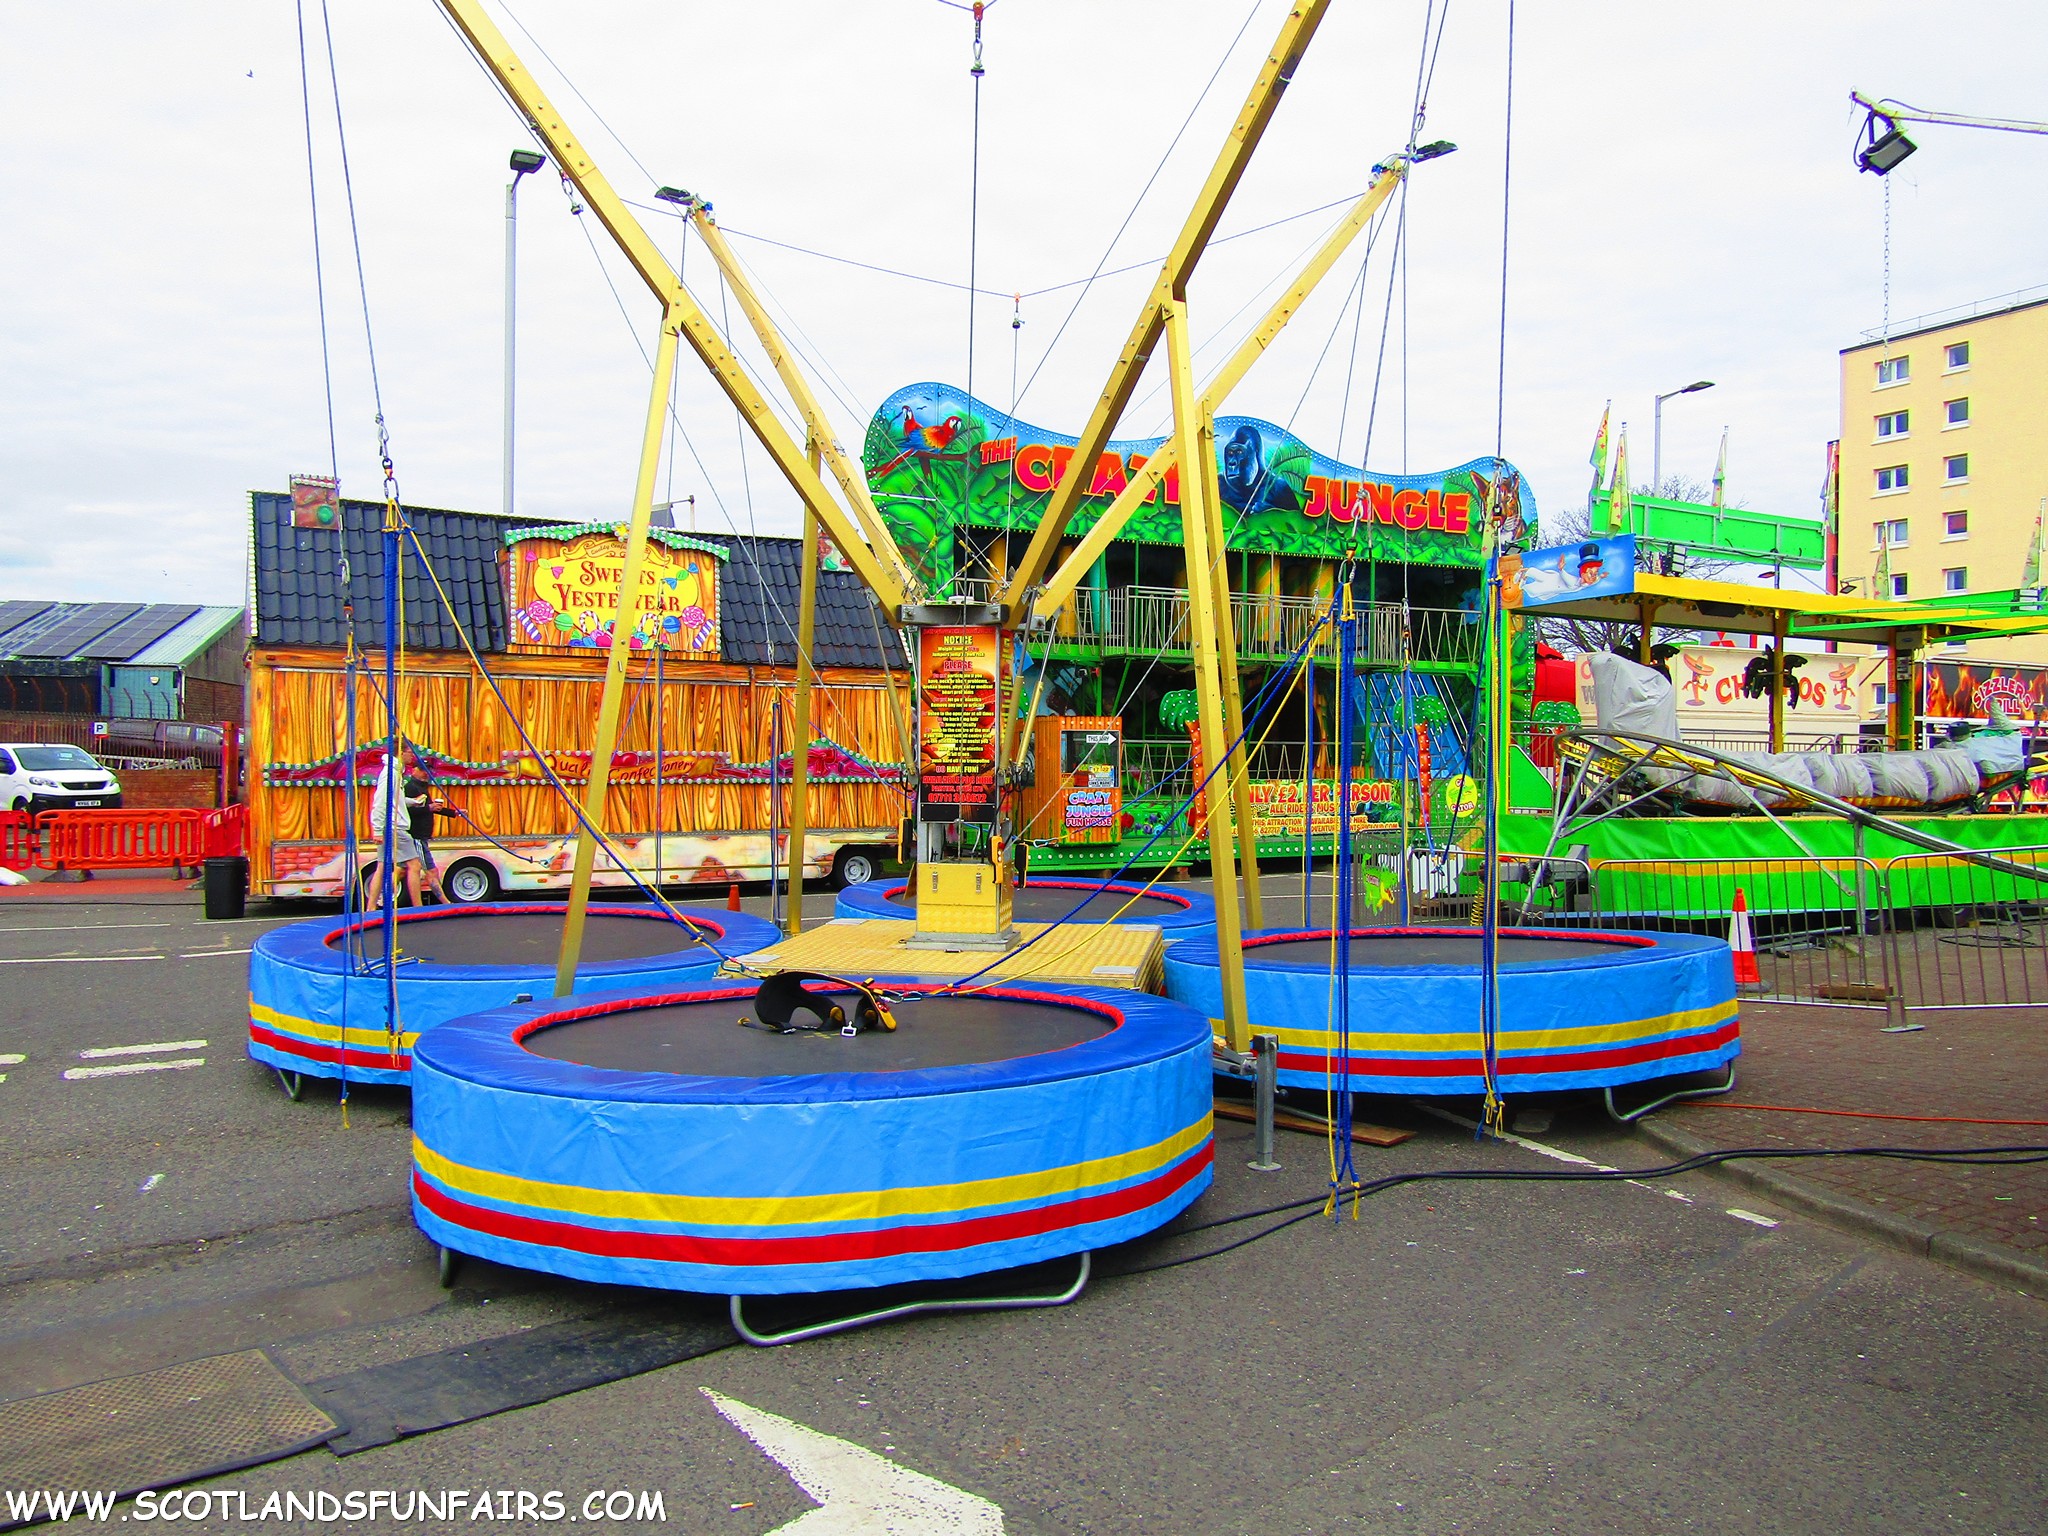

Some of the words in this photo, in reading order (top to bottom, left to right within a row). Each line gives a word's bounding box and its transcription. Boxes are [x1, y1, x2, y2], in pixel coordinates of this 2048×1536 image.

[980, 436, 1018, 465] THE
[1304, 475, 1471, 534] JUNGLE
[580, 561, 656, 587] SWETS
[552, 584, 681, 613] YESTEYEAR
[944, 635, 973, 645] NOTICE
[944, 660, 973, 671] PLEASE
[1715, 673, 1826, 708] CHOS
[1971, 676, 2032, 711] SIZZLERS
[96, 724, 104, 732] P
[544, 753, 592, 777] Quali
[608, 760, 696, 781] Confecionery
[964, 765, 979, 773] FUN!
[1068, 791, 1112, 804] CRAZY
[1232, 784, 1273, 804] NLY
[1278, 784, 1297, 804] £2
[1303, 784, 1330, 803] ER
[1336, 782, 1392, 803] PRSON
[1066, 804, 1113, 818] JUNGLE
[1270, 803, 1284, 814] ALL
[1286, 803, 1315, 813] RIDES
[1316, 803, 1339, 812] MUS
[1066, 817, 1084, 827] FUN
[1085, 817, 1112, 827] HOUSE
[1266, 817, 1303, 827] ATTRACTION
[1311, 816, 1340, 825] AVAILABE
[1353, 815, 1367, 824] HIRE
